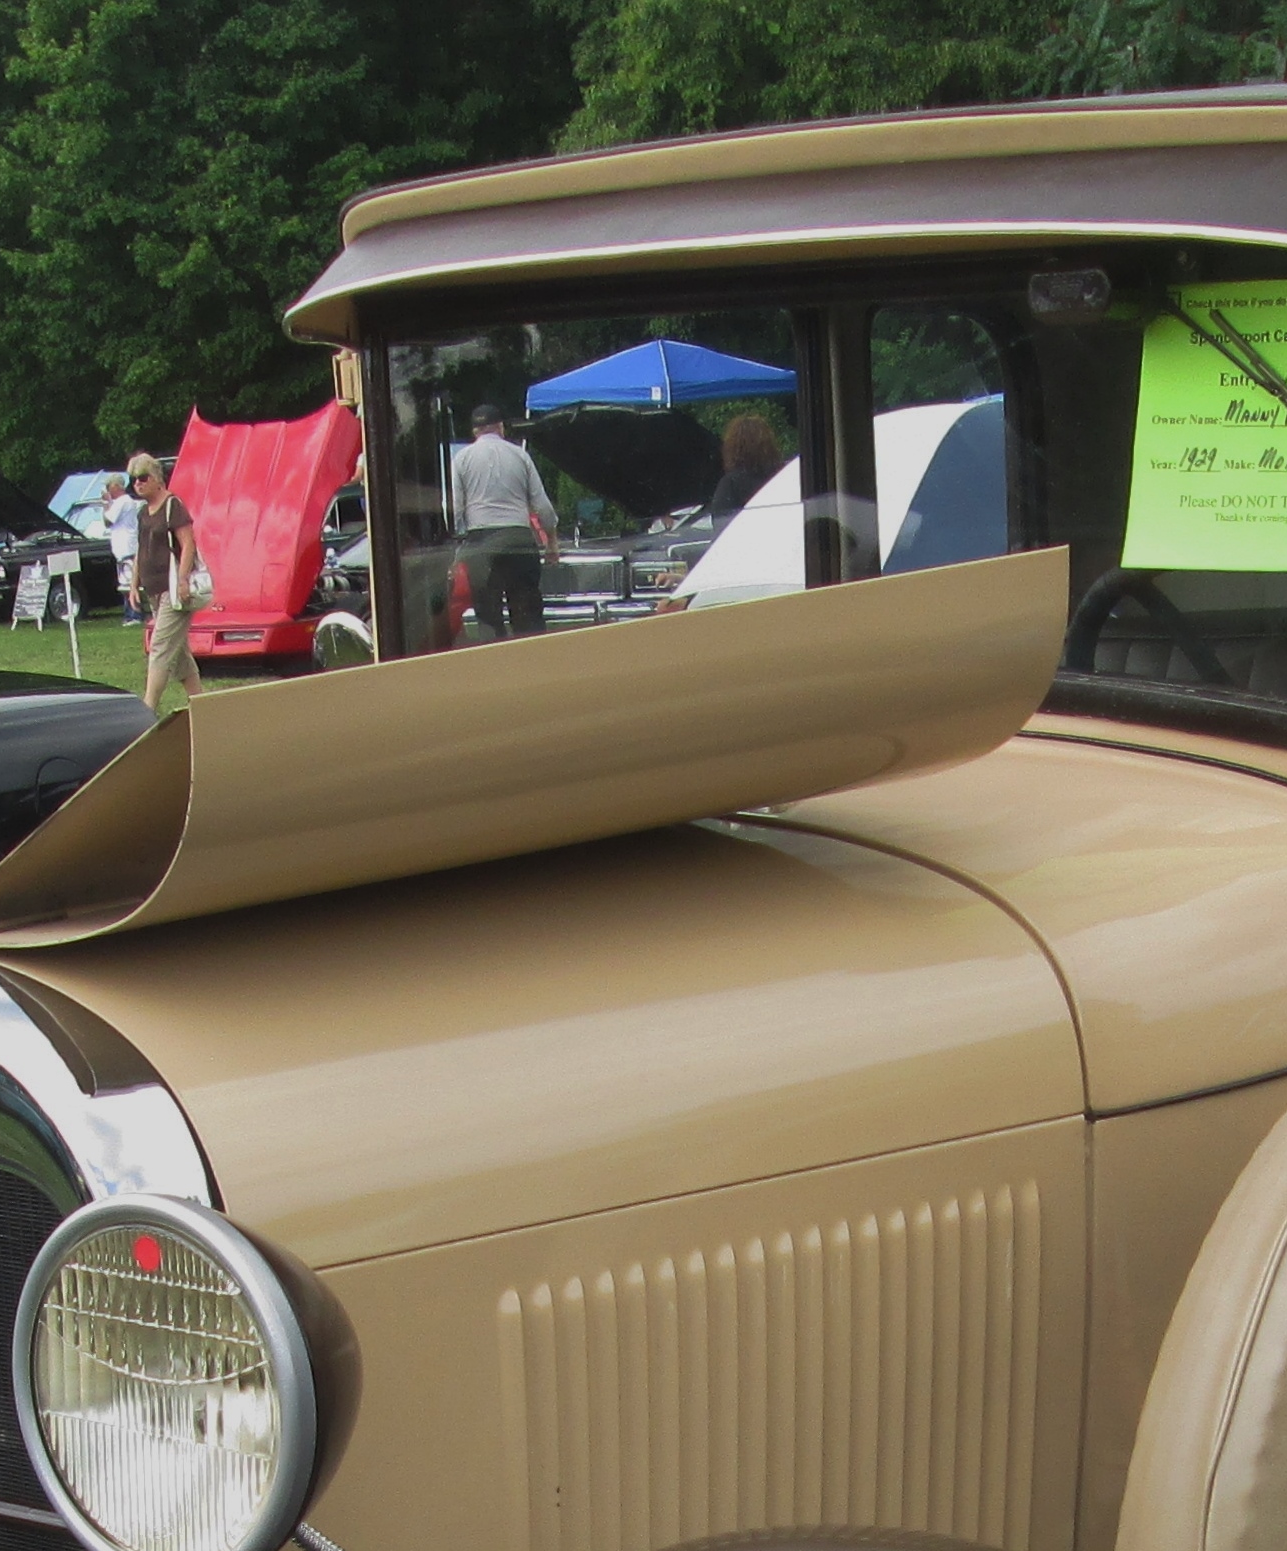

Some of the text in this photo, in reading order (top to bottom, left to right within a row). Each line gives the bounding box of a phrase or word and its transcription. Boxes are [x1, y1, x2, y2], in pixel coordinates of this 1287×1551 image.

[1152, 414, 1187, 426] Owner
[1189, 413, 1222, 426] Name:
[1150, 459, 1177, 471] Year:
[1179, 446, 1217, 472] 1929
[1224, 458, 1255, 470] Make:
[1179, 494, 1217, 509] Please
[1221, 495, 1242, 509] DO
[1247, 495, 1276, 509] NOT
